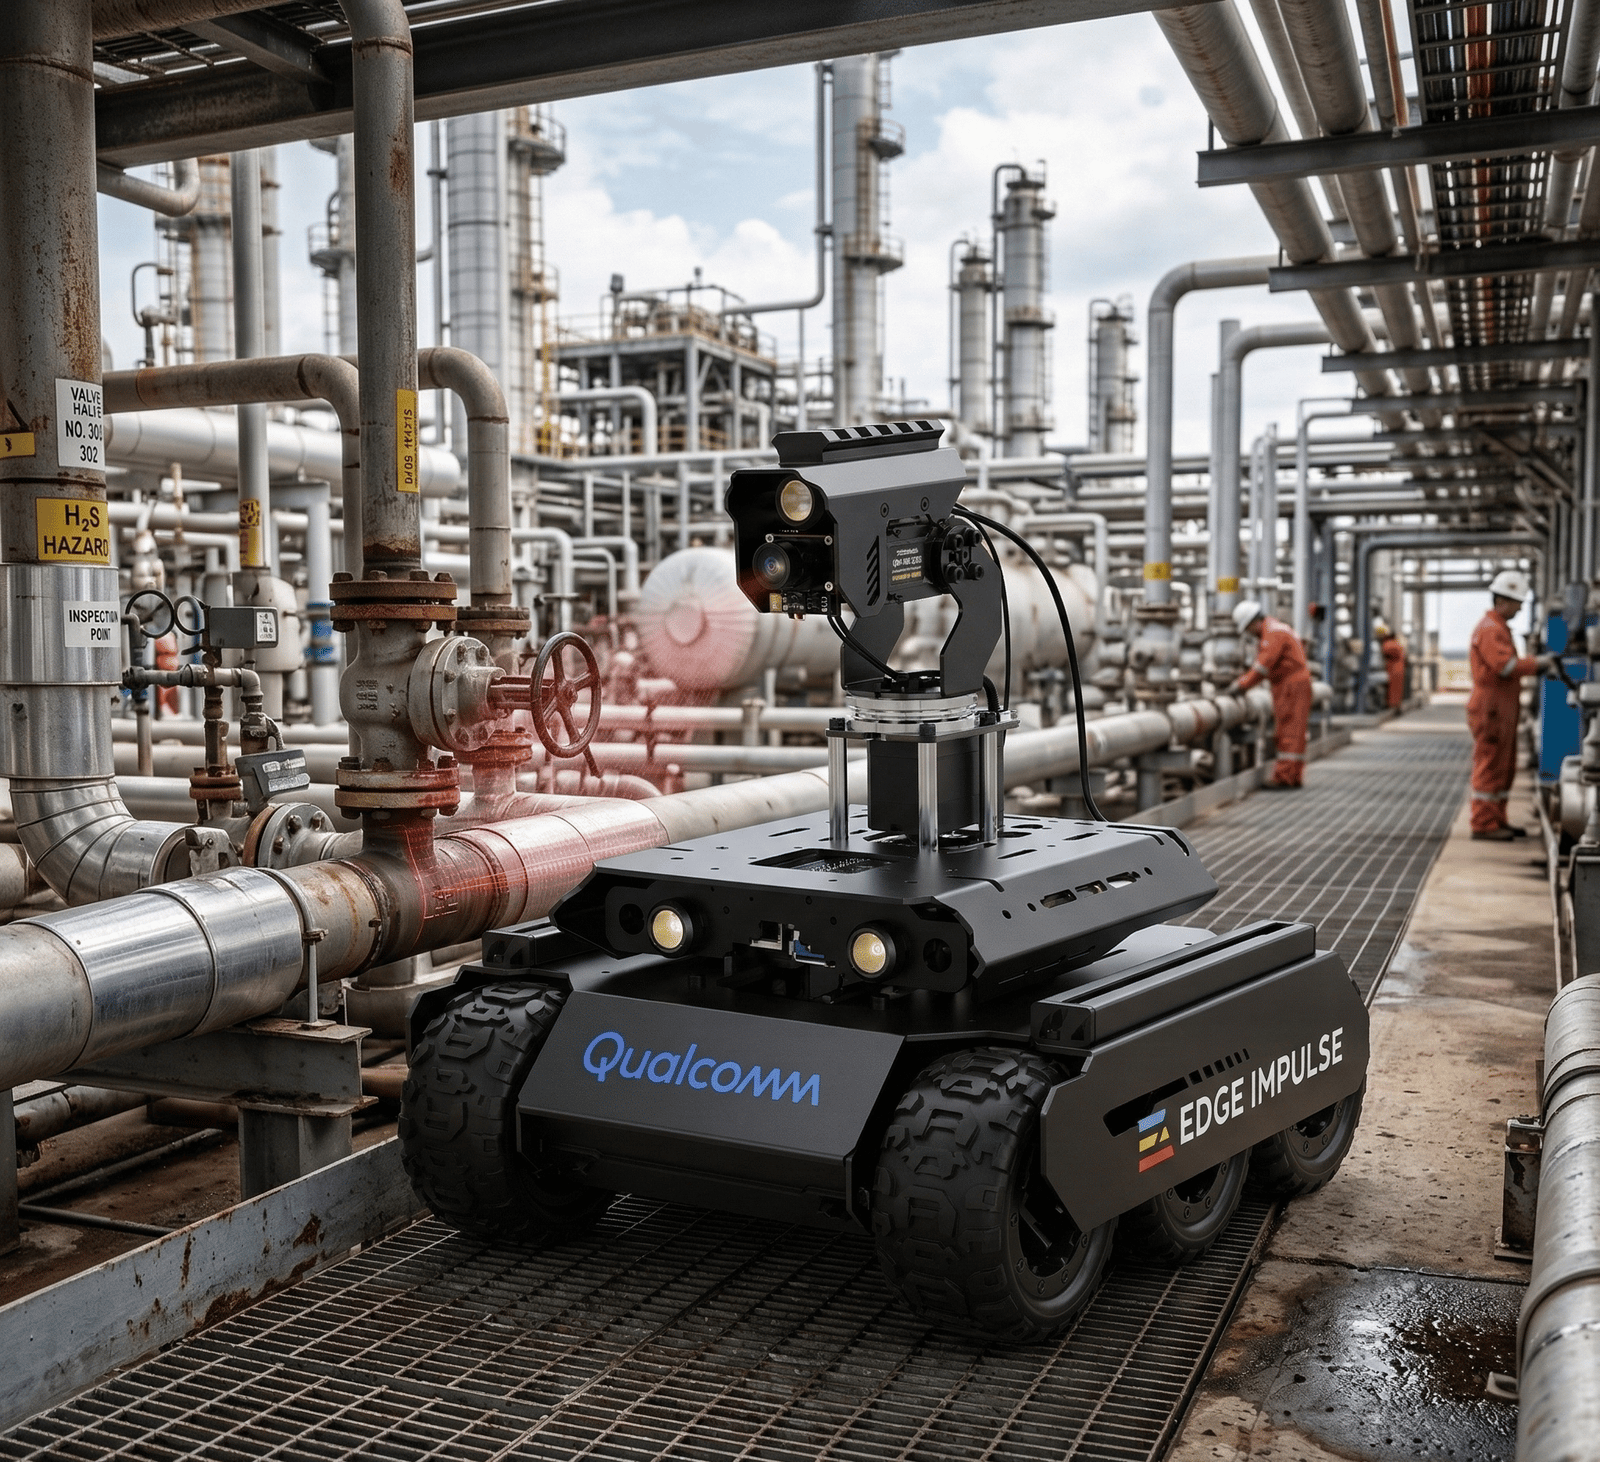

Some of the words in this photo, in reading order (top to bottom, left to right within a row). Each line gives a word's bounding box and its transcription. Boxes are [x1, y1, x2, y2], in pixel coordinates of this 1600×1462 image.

[70, 386, 101, 405] VALVE
[65, 420, 86, 438] NO.
[80, 444, 98, 463] 302
[65, 504, 100, 532] H2S
[44, 535, 109, 557] HAZARD
[583, 1031, 820, 1106] Qualcomm
[1180, 1076, 1245, 1145] EDGE
[1251, 1026, 1344, 1109] IMPULSE
